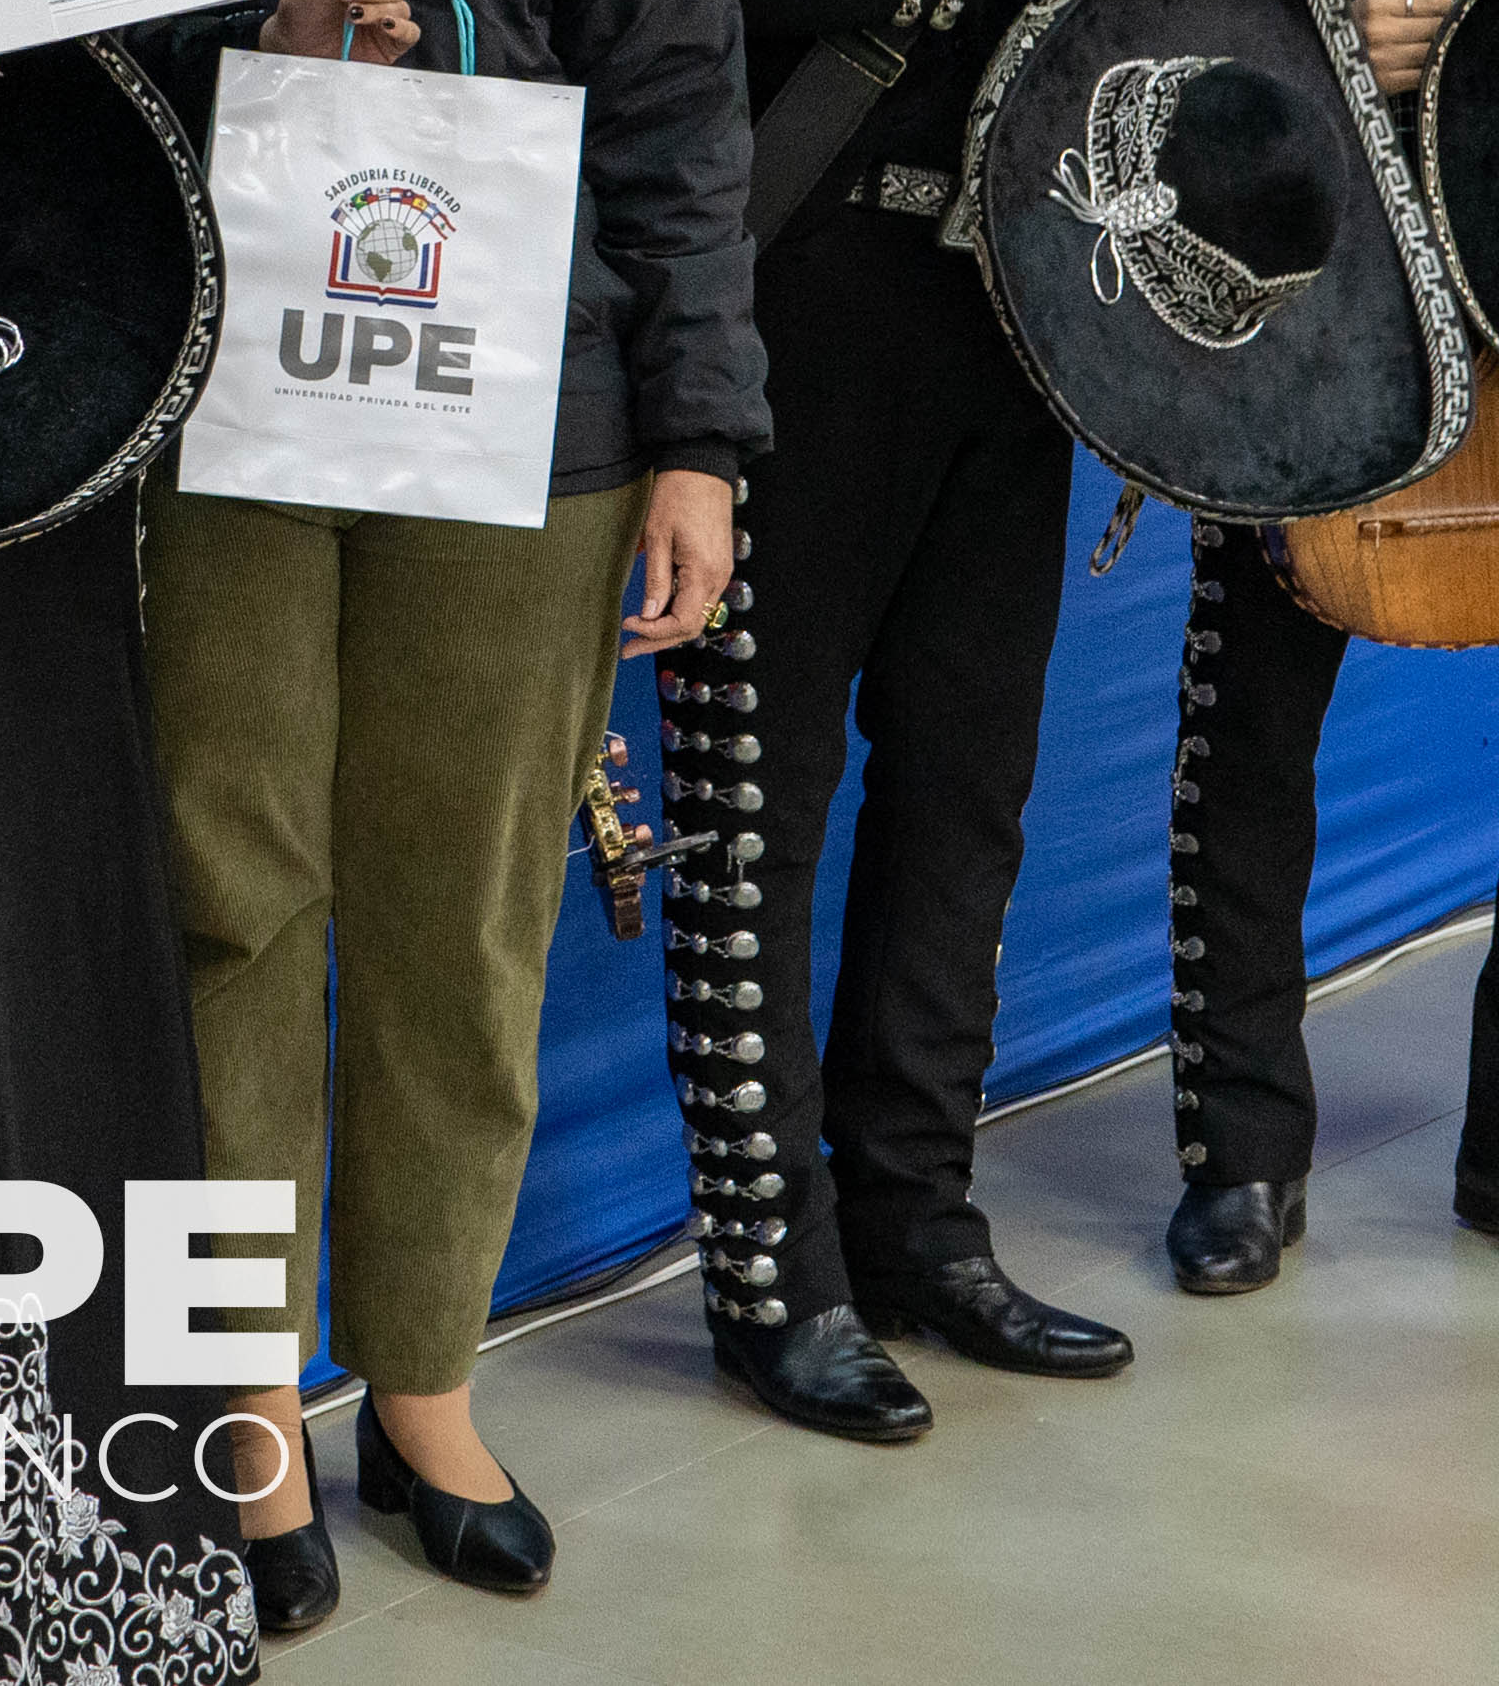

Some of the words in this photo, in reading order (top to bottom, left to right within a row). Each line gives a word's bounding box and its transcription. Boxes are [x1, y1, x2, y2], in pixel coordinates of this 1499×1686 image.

[324, 168, 389, 201] SABIDURIA
[393, 169, 406, 181] ES
[409, 172, 461, 213] LIBERTAD
[279, 308, 477, 396] UPE
[274, 387, 353, 402] UNIVERSIDAD
[359, 396, 410, 408] PRIVADA
[415, 402, 436, 411] DEL
[443, 405, 472, 414] ESTE
